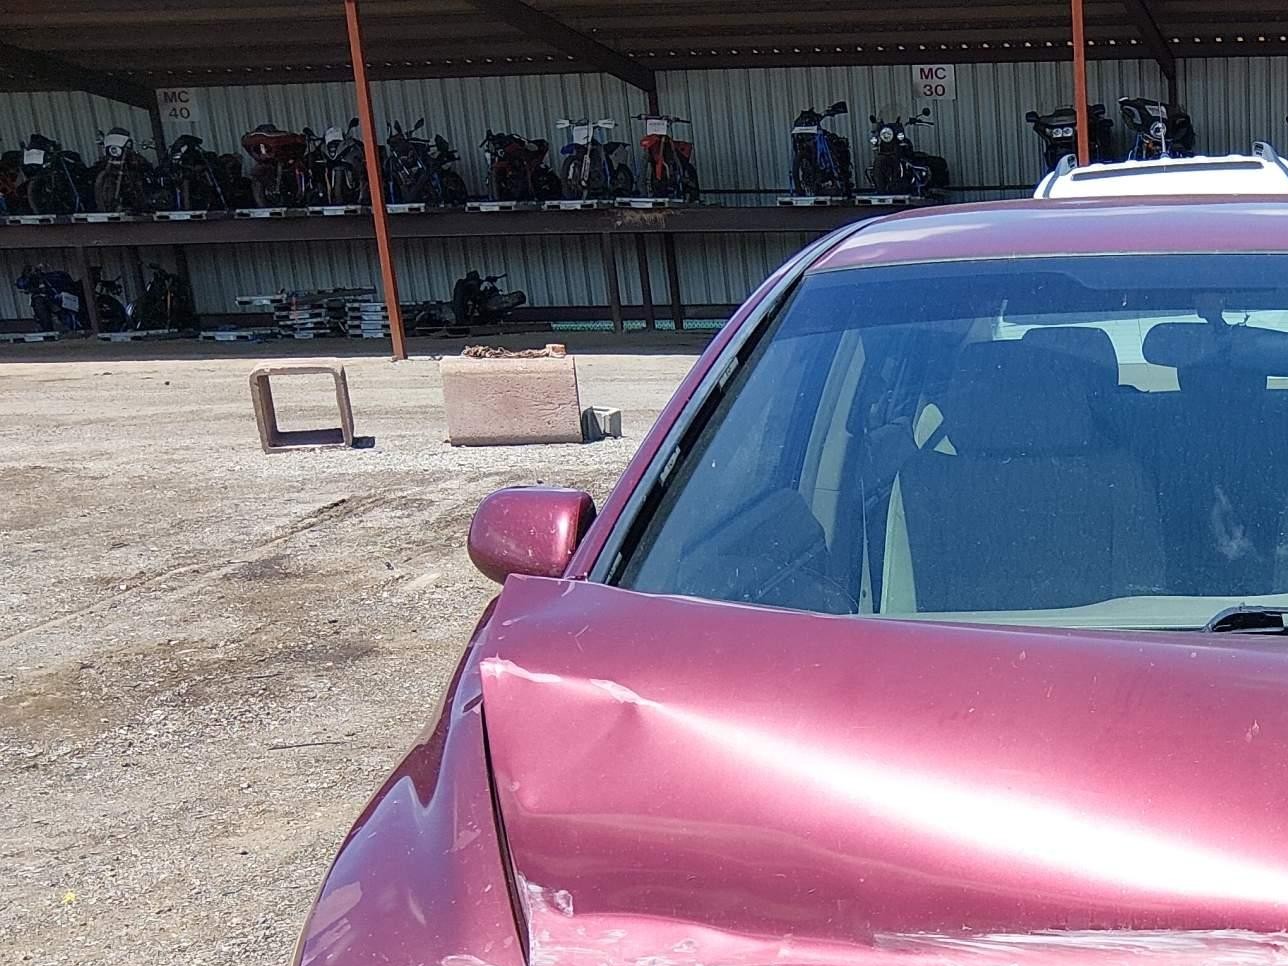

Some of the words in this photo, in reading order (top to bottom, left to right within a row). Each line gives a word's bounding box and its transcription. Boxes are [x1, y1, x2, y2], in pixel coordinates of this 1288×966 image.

[920, 67, 947, 80] MC
[163, 90, 190, 103] MC
[923, 84, 946, 97] 30
[169, 107, 190, 120] 40
